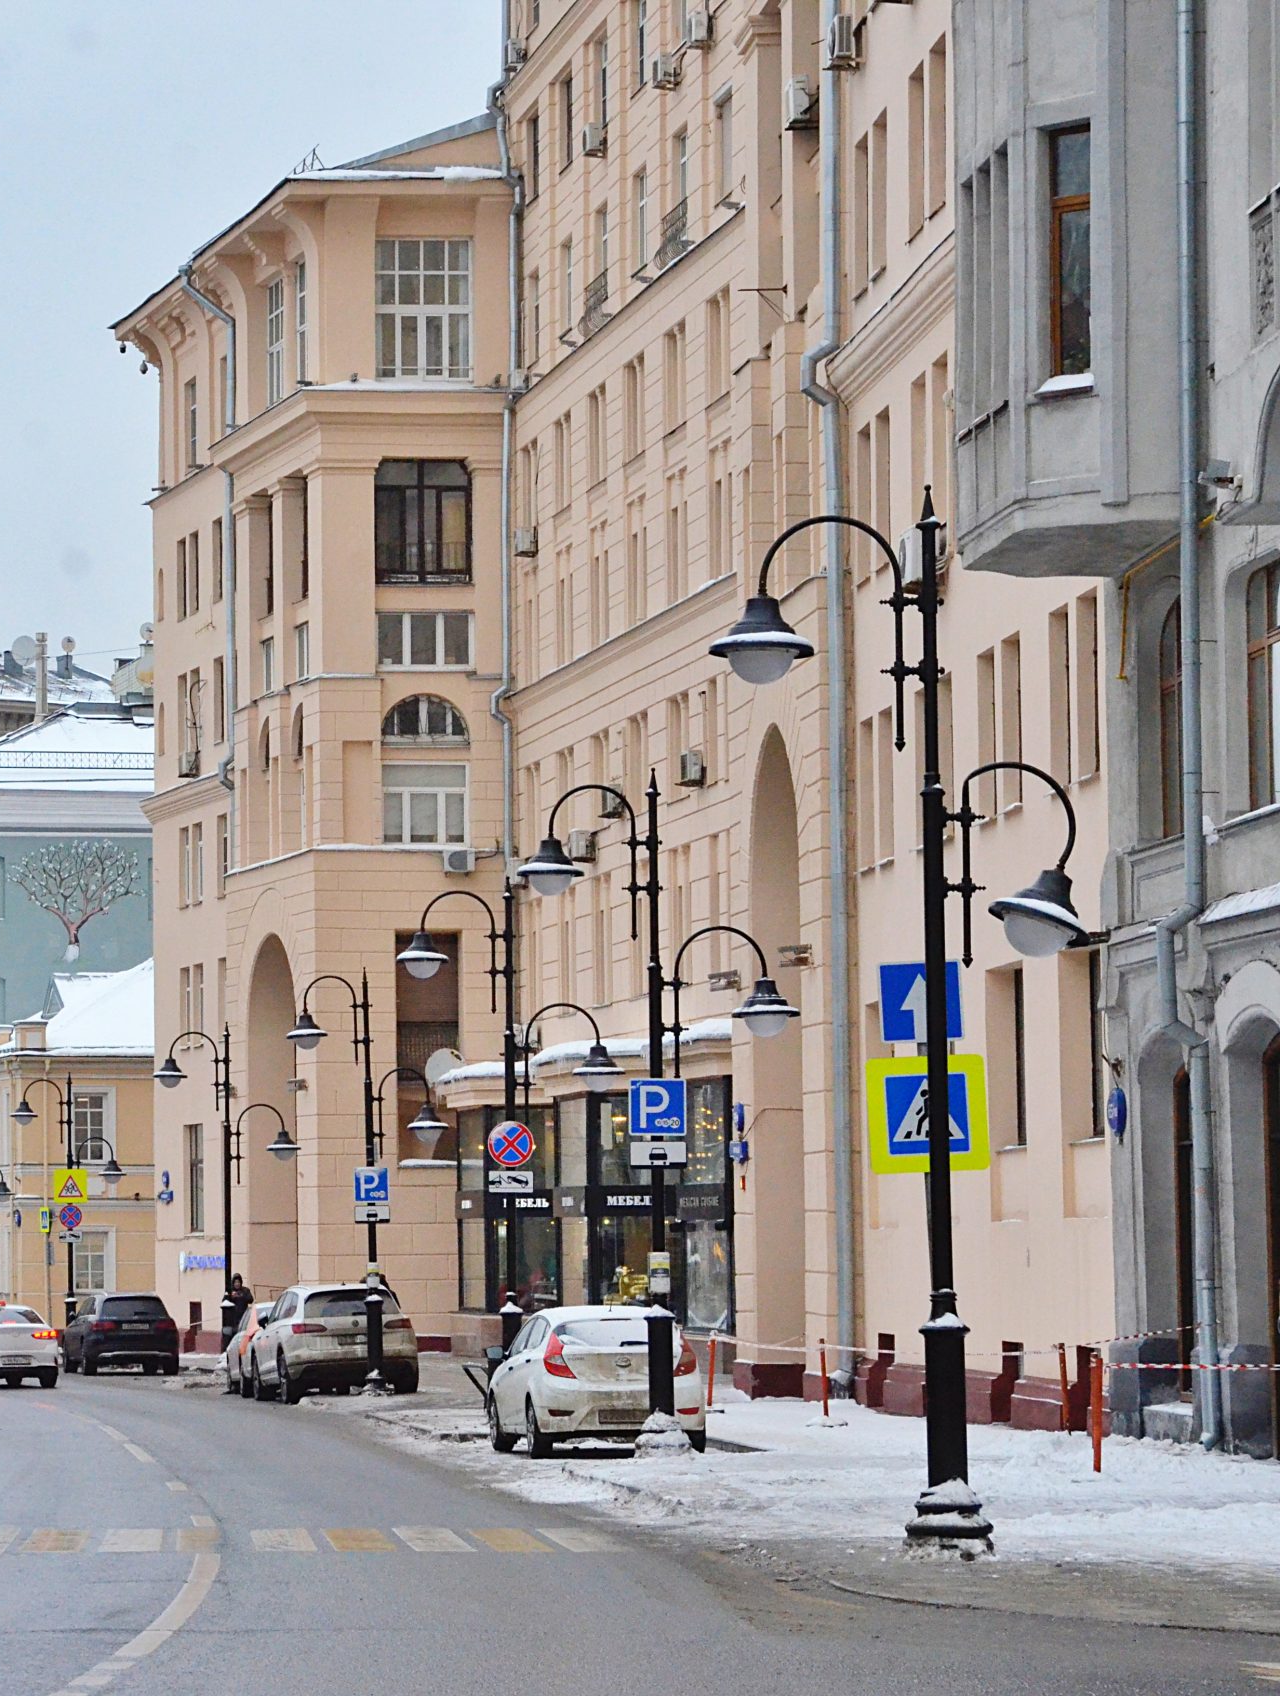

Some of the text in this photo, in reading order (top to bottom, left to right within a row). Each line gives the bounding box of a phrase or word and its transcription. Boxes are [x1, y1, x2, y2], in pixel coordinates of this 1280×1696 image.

[639, 1085, 670, 1128] P
[360, 1171, 380, 1199] P
[503, 1198, 550, 1208] ЕБЕЛЬ
[606, 1195, 653, 1206] МЕБЕЛ
